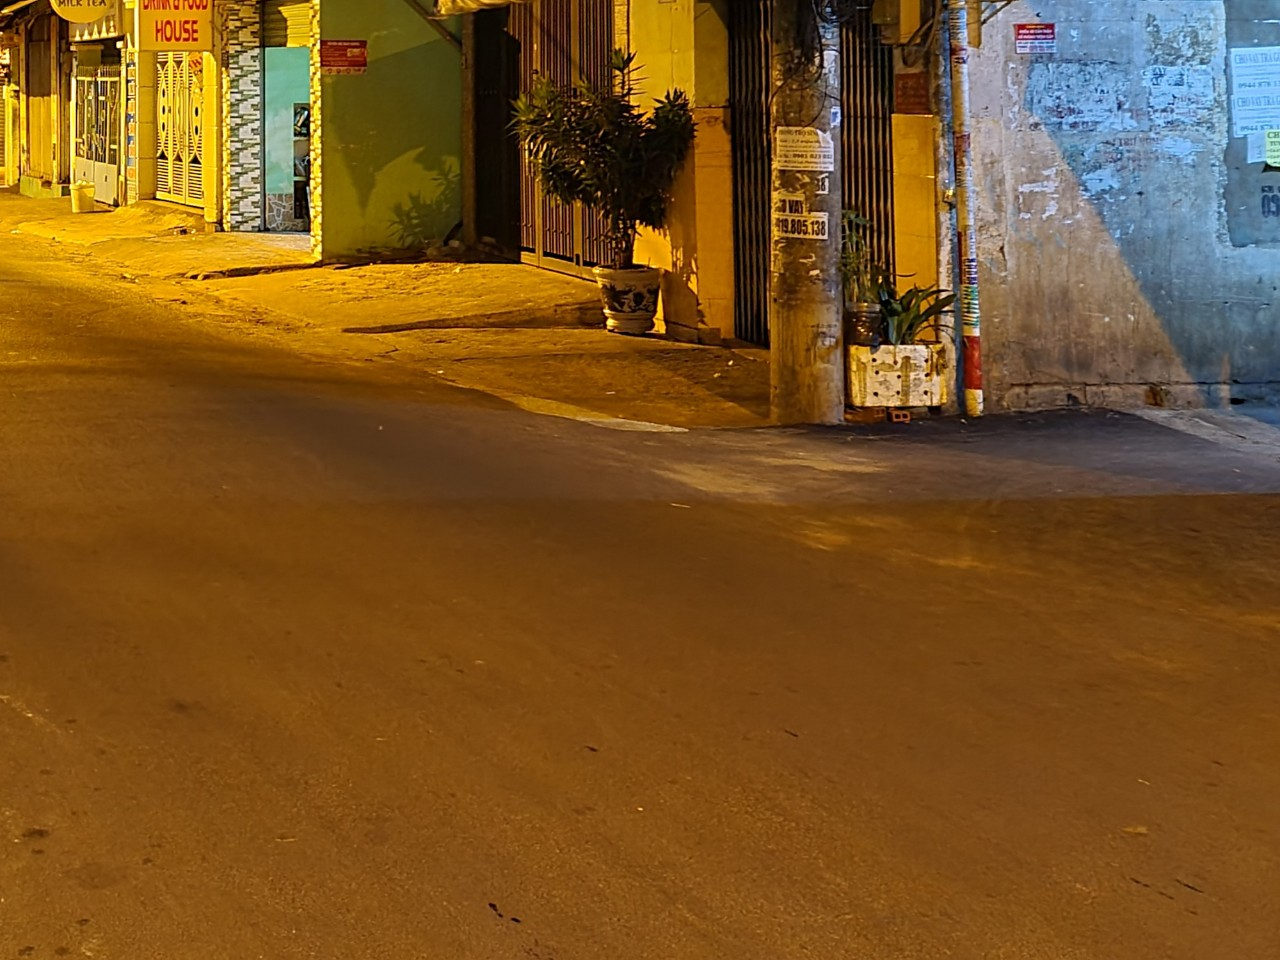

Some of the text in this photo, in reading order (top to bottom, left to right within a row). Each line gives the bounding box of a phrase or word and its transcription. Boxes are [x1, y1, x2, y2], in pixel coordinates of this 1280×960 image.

[155, 20, 199, 42] HOUSE
[1261, 194, 1280, 217] 09
[778, 218, 826, 237] 19.805.138
